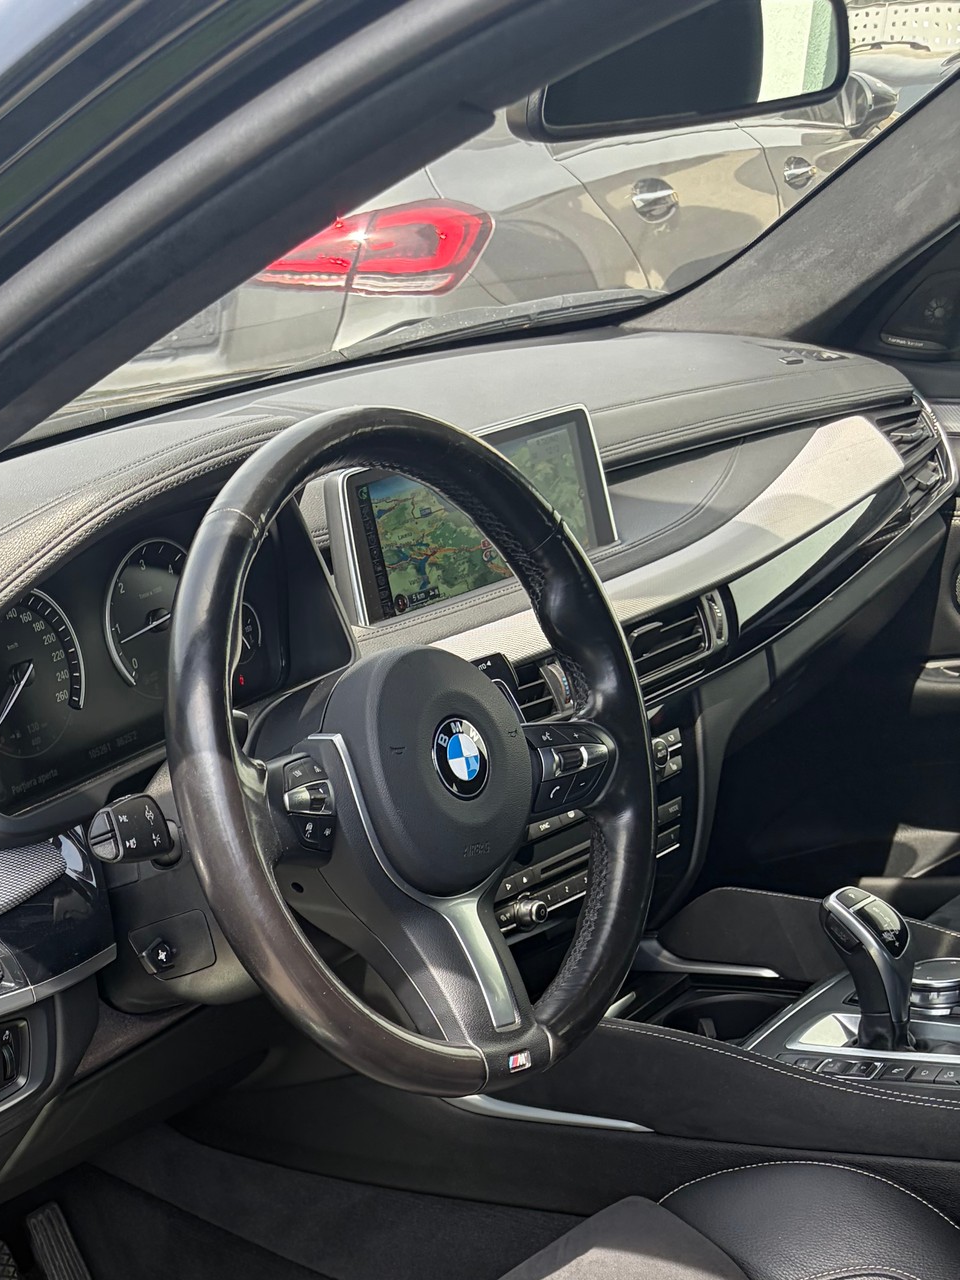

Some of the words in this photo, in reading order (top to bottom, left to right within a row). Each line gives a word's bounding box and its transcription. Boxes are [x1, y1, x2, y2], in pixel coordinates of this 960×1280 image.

[140, 559, 146, 571] 3
[168, 564, 174, 575] 4
[118, 583, 126, 594] 2
[412, 594, 417, 602] 5
[20, 611, 33, 624] 160
[32, 620, 45, 633] 180
[115, 624, 121, 634] 1
[42, 632, 57, 646] 200
[51, 649, 65, 662] 220
[131, 658, 138, 669] 0
[55, 670, 70, 683] 240
[55, 689, 69, 703] 260
[438, 721, 480, 748] BMW
